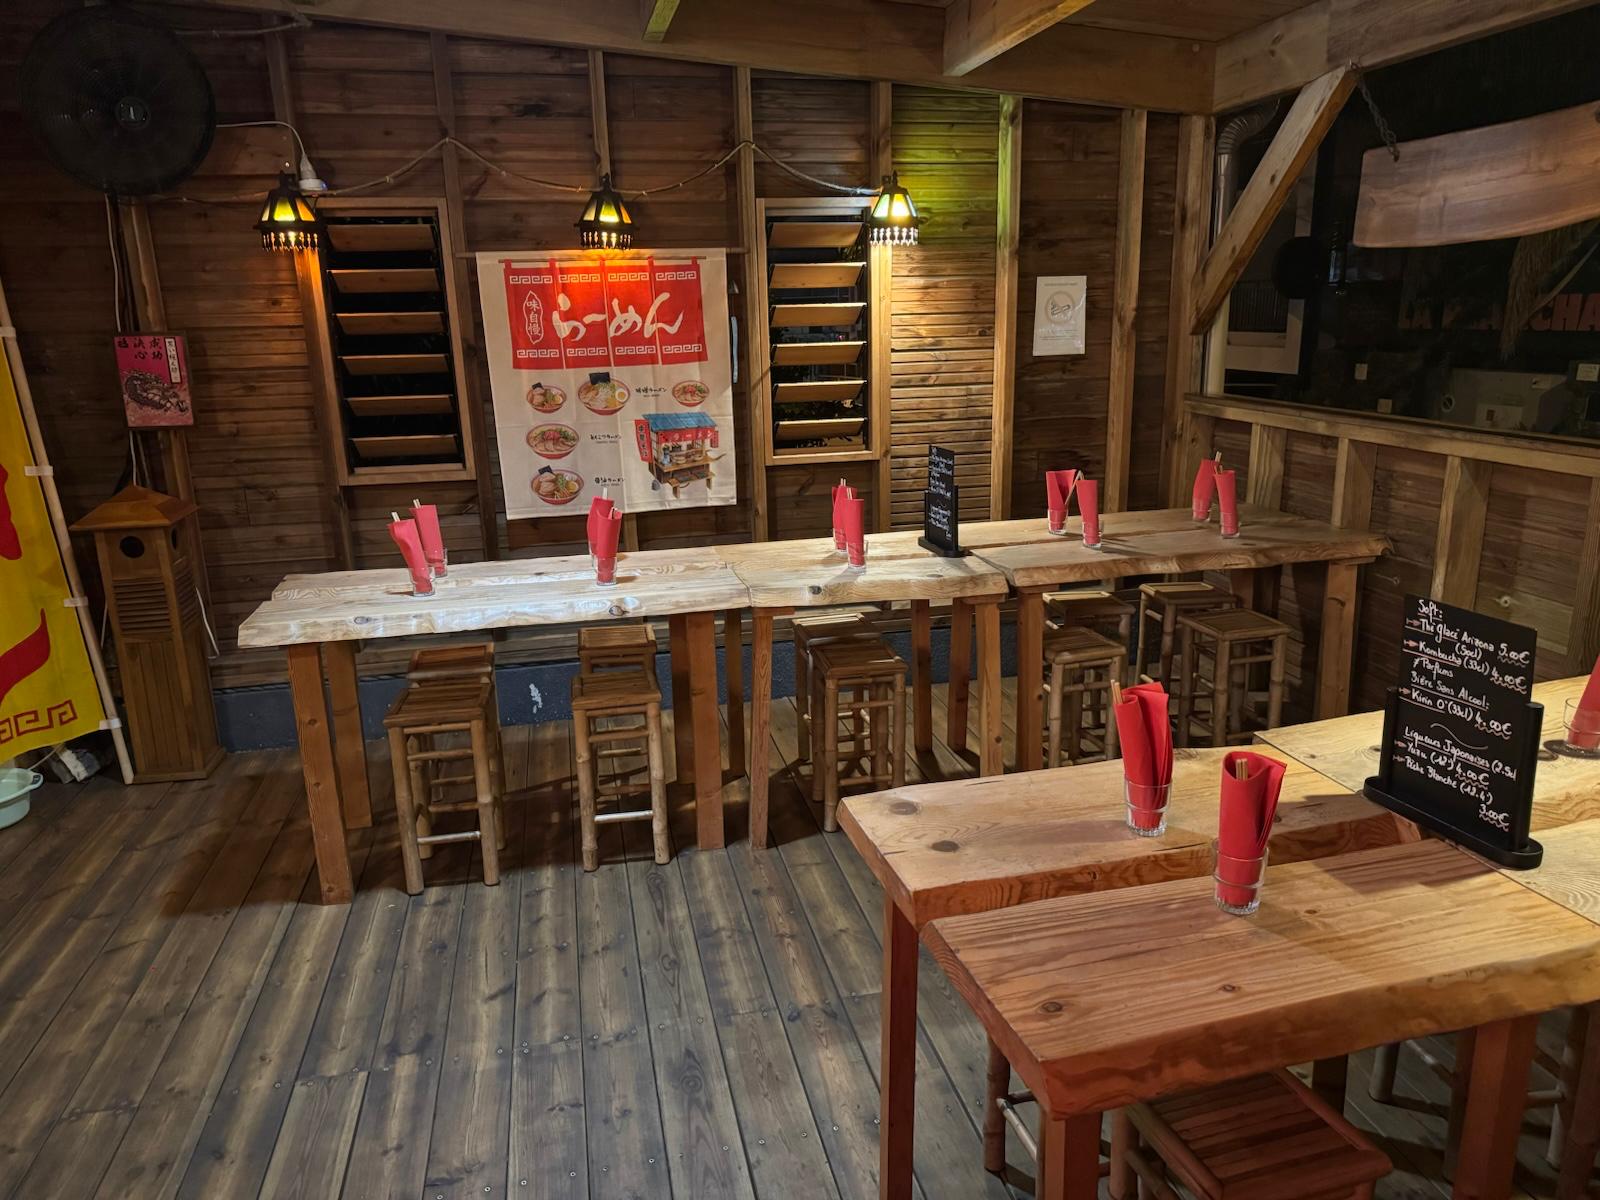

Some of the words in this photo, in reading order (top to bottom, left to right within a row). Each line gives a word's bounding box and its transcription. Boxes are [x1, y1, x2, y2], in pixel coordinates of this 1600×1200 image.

[526, 300, 542, 337] 味自慢
[552, 292, 684, 342] らーめん
[1417, 599, 1443, 623] Soft:
[1461, 631, 1495, 652] Arizona
[1419, 640, 1462, 666] Kombucha
[1463, 656, 1491, 676] (33cl)
[1420, 657, 1454, 680] Parfums
[1411, 688, 1433, 706] Kirin
[1436, 680, 1455, 696] Sans
[1458, 686, 1490, 709] Alcool:
[1407, 741, 1428, 759] Yuzu
[1443, 738, 1490, 767] Japonaises
[1426, 765, 1457, 789] Blanche
